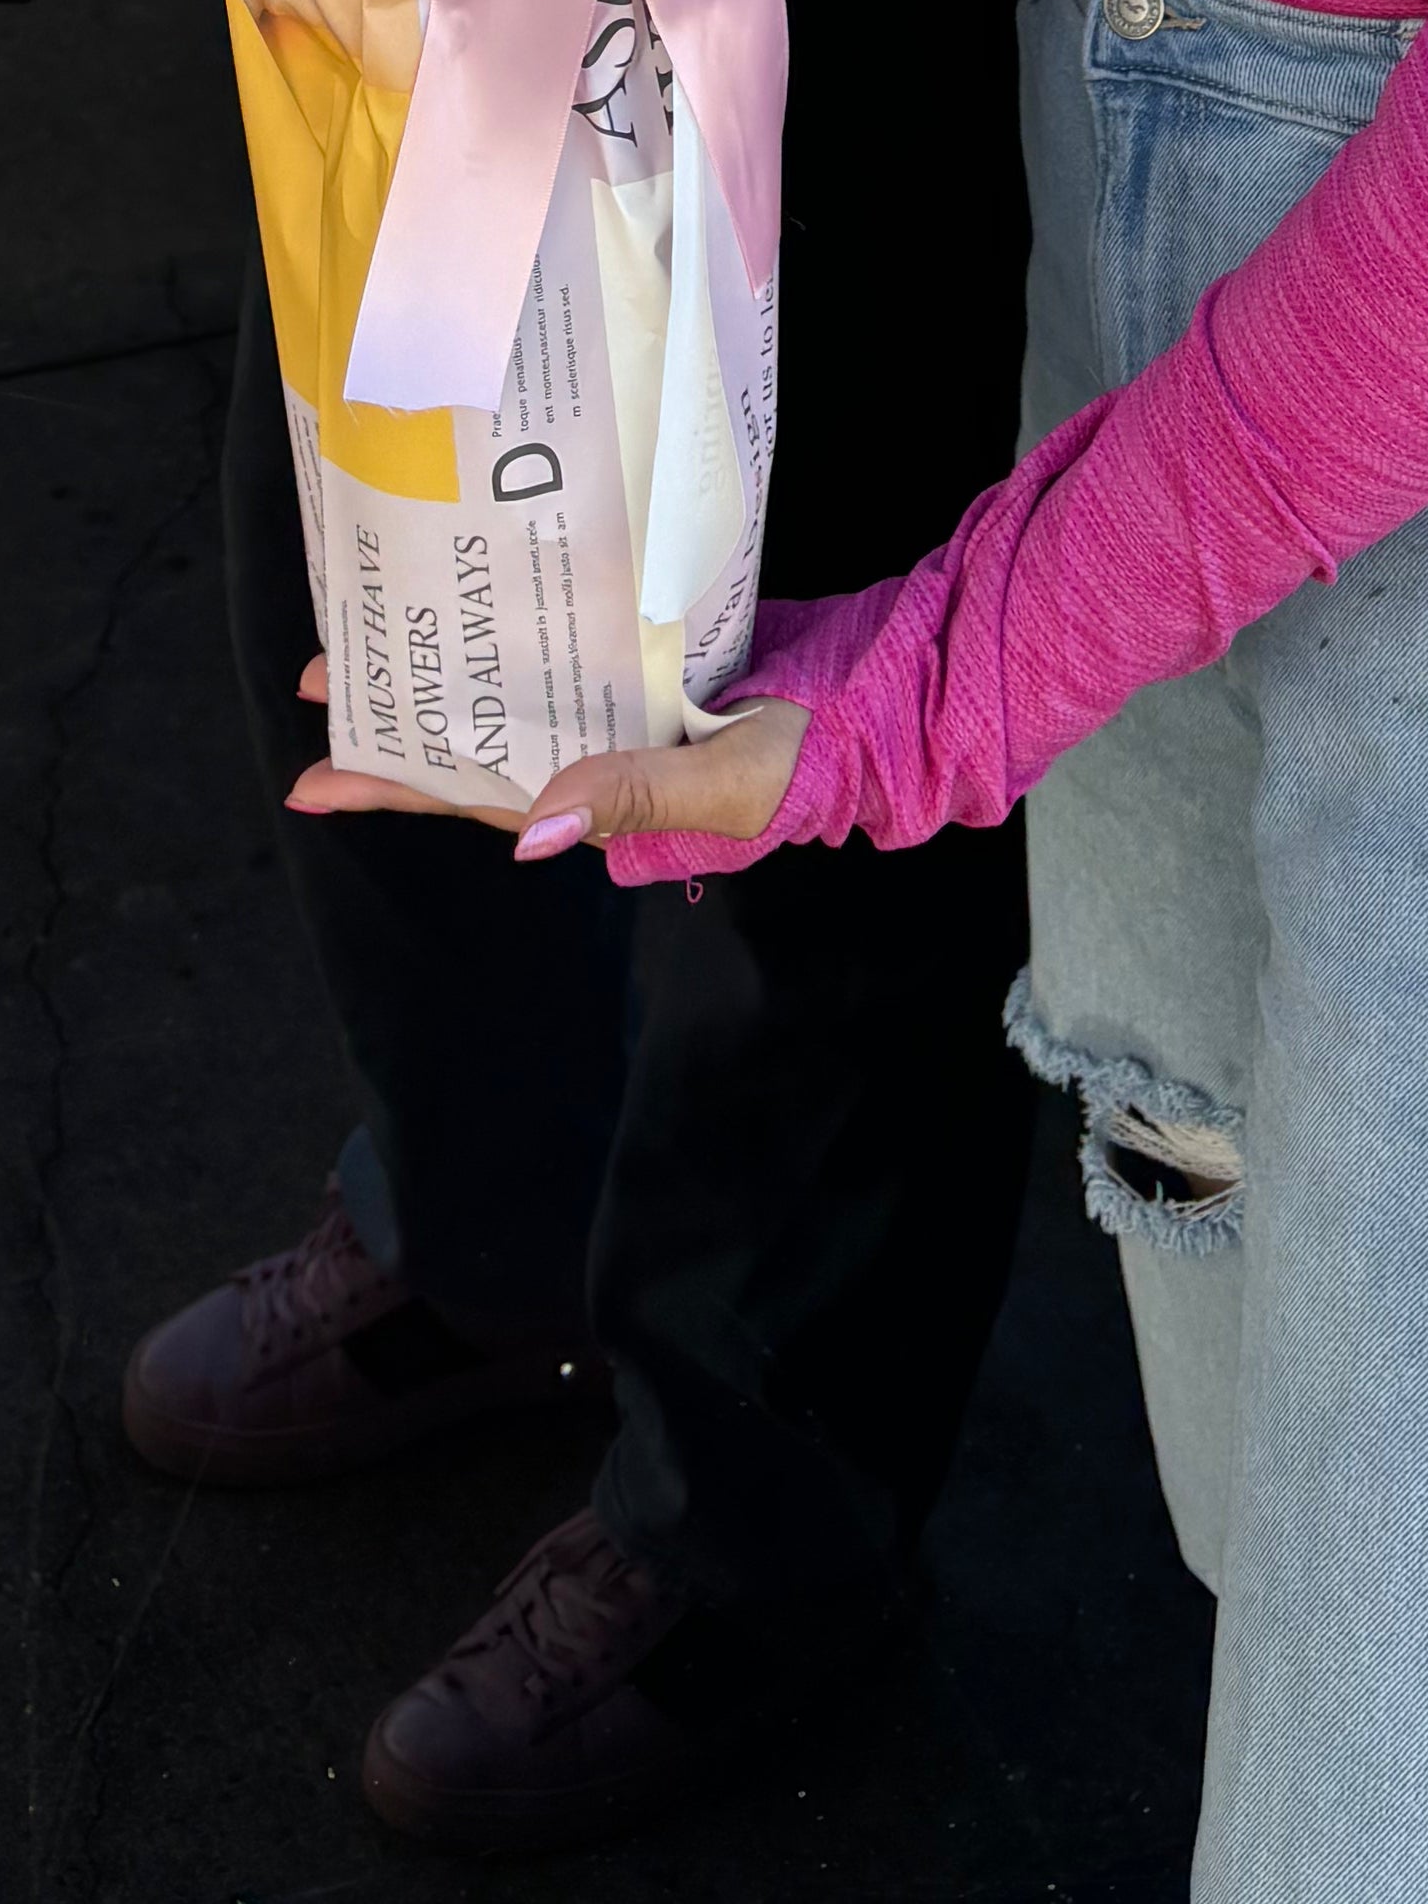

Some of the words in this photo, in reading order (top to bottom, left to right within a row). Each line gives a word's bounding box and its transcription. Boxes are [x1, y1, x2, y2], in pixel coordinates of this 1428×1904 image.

[559, 282, 571, 306] sed.
[562, 307, 573, 335] risus
[512, 336, 528, 393] penatibus
[565, 337, 579, 399] scelerisque
[517, 397, 530, 432] toque
[544, 404, 555, 424] ent
[488, 438, 568, 508] D
[356, 523, 387, 637] HAVE
[454, 532, 502, 688] ALWAYS
[365, 635, 403, 742] MUST
[406, 604, 457, 771] FLOWERS
[376, 744, 405, 759] I
[473, 693, 510, 781] AND
